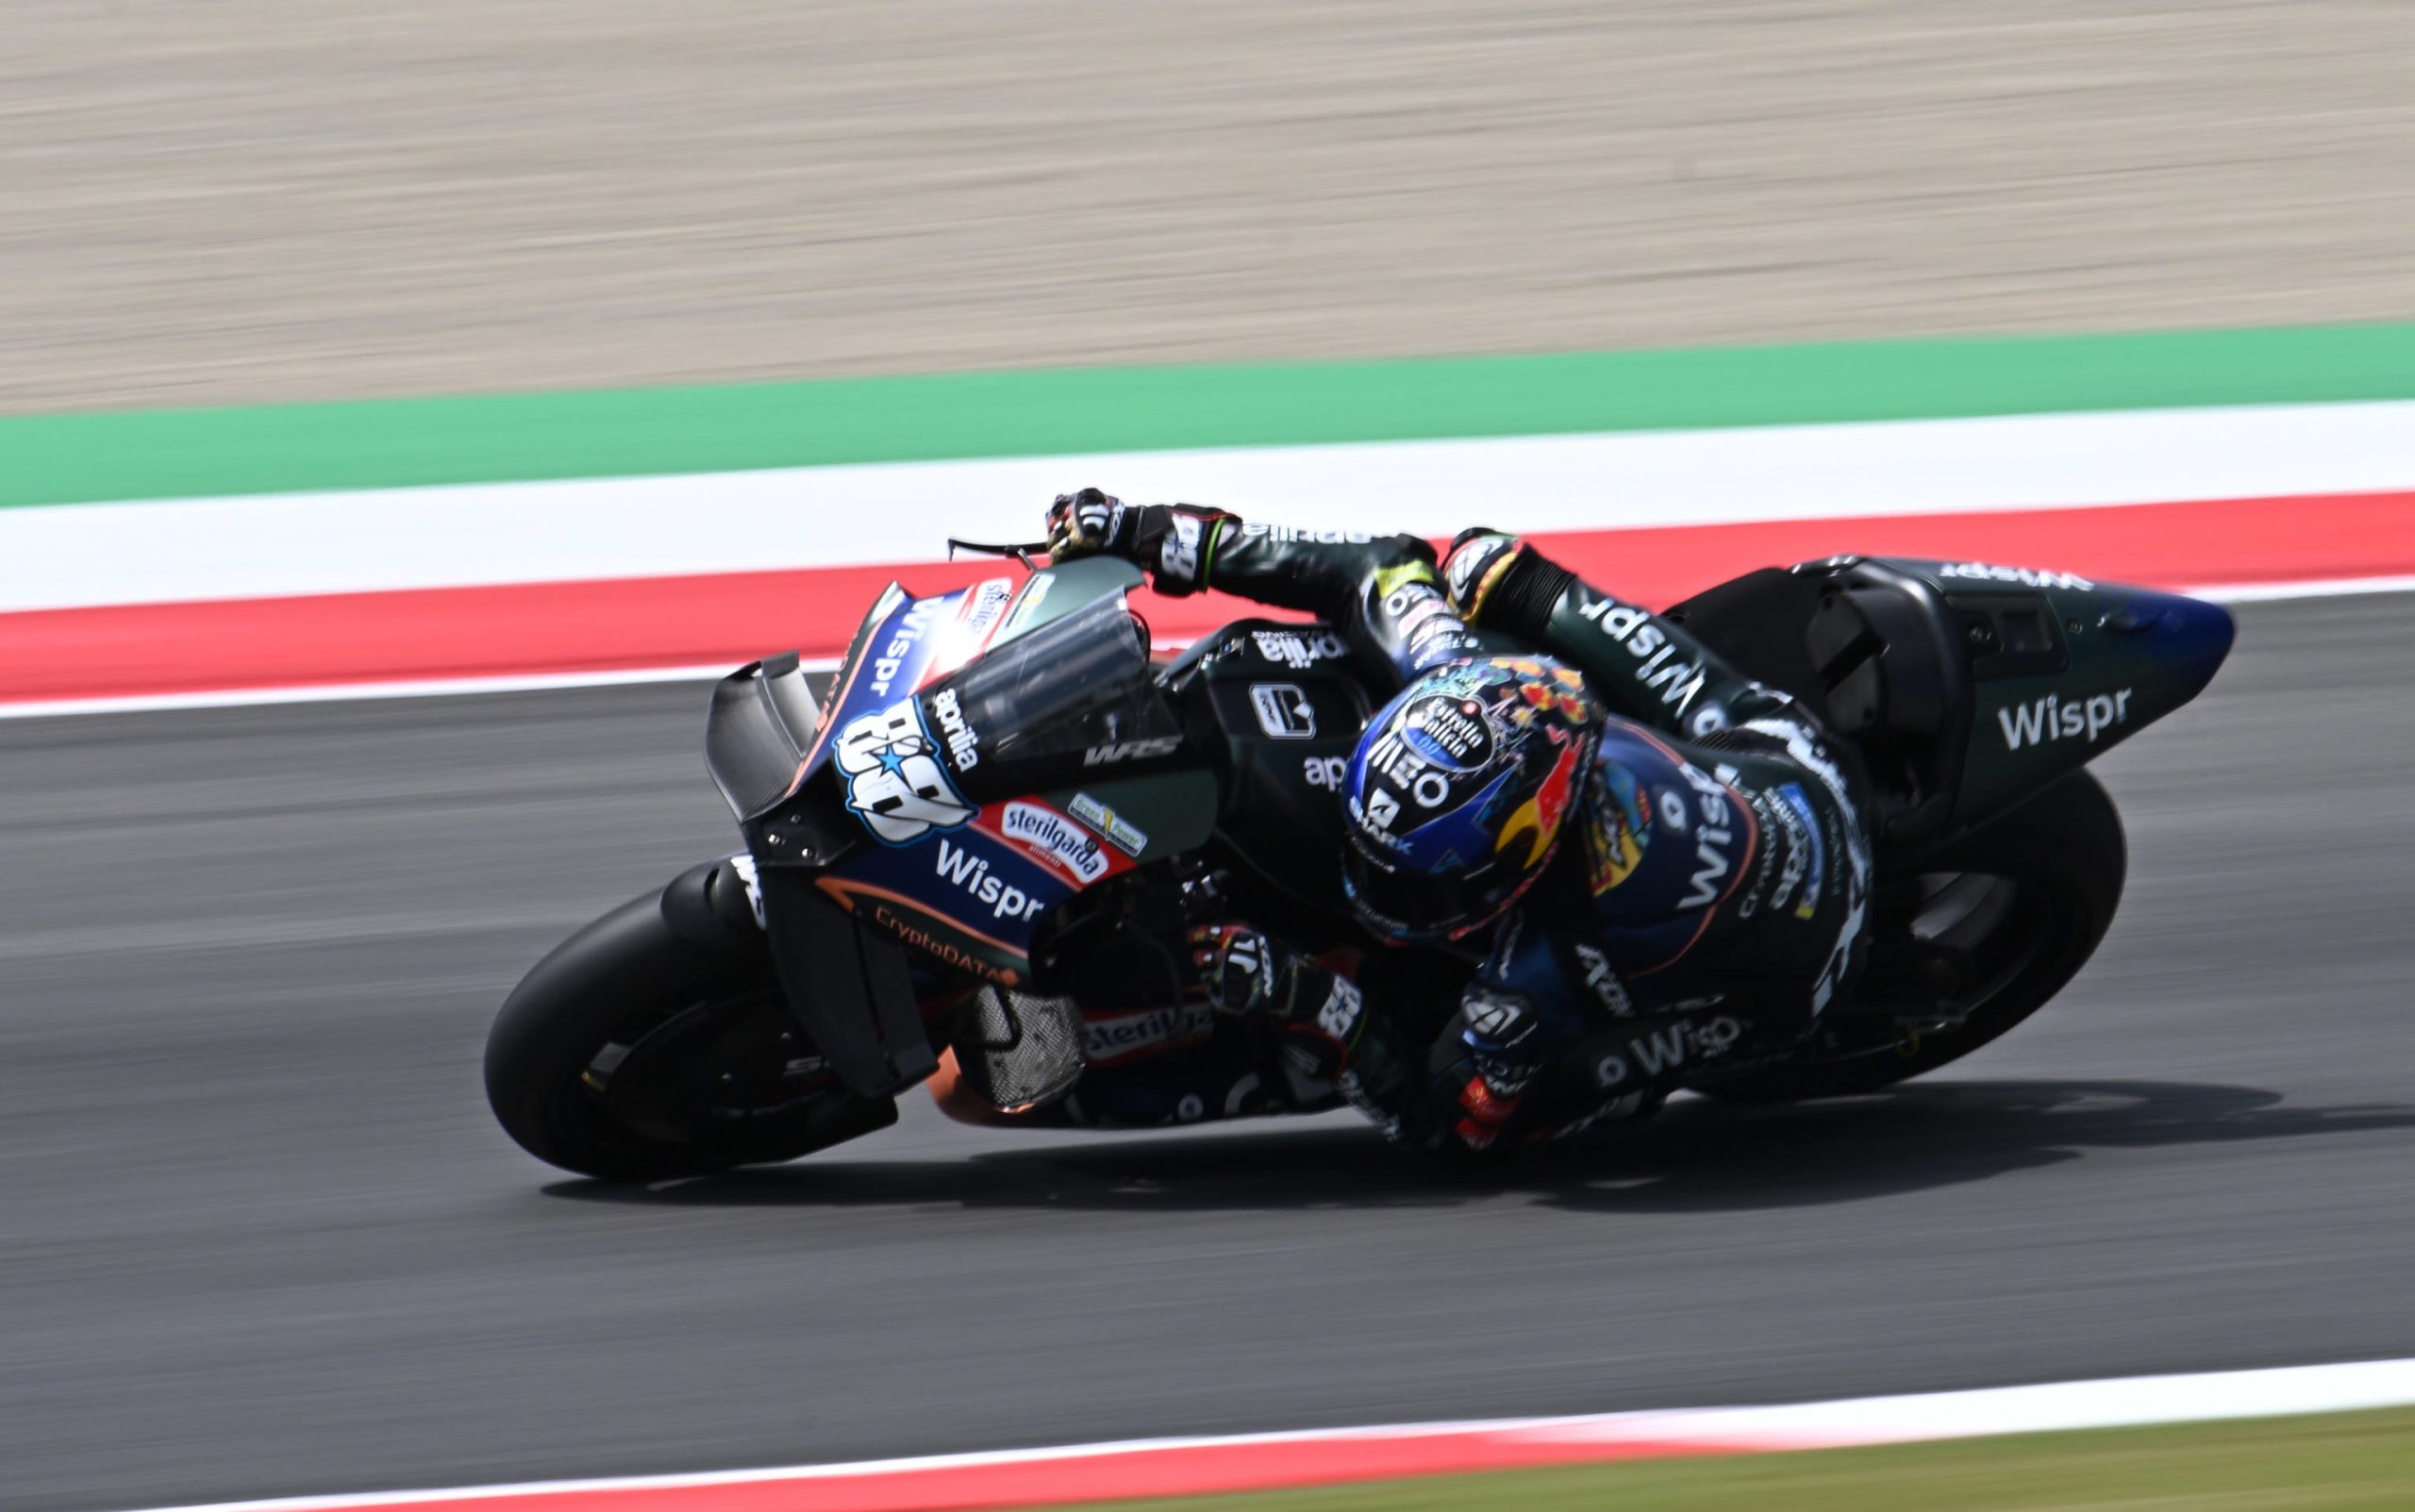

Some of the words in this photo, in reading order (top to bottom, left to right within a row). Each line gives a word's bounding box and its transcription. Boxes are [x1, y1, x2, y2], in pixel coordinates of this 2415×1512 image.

[1578, 597, 1707, 720] Wispr
[934, 688, 979, 772] aprilia
[1997, 687, 2132, 751] Wispr
[937, 839, 1045, 922] Wispr
[1007, 807, 1100, 876] sterilgarda
[874, 905, 1003, 982] CryptoDATA
